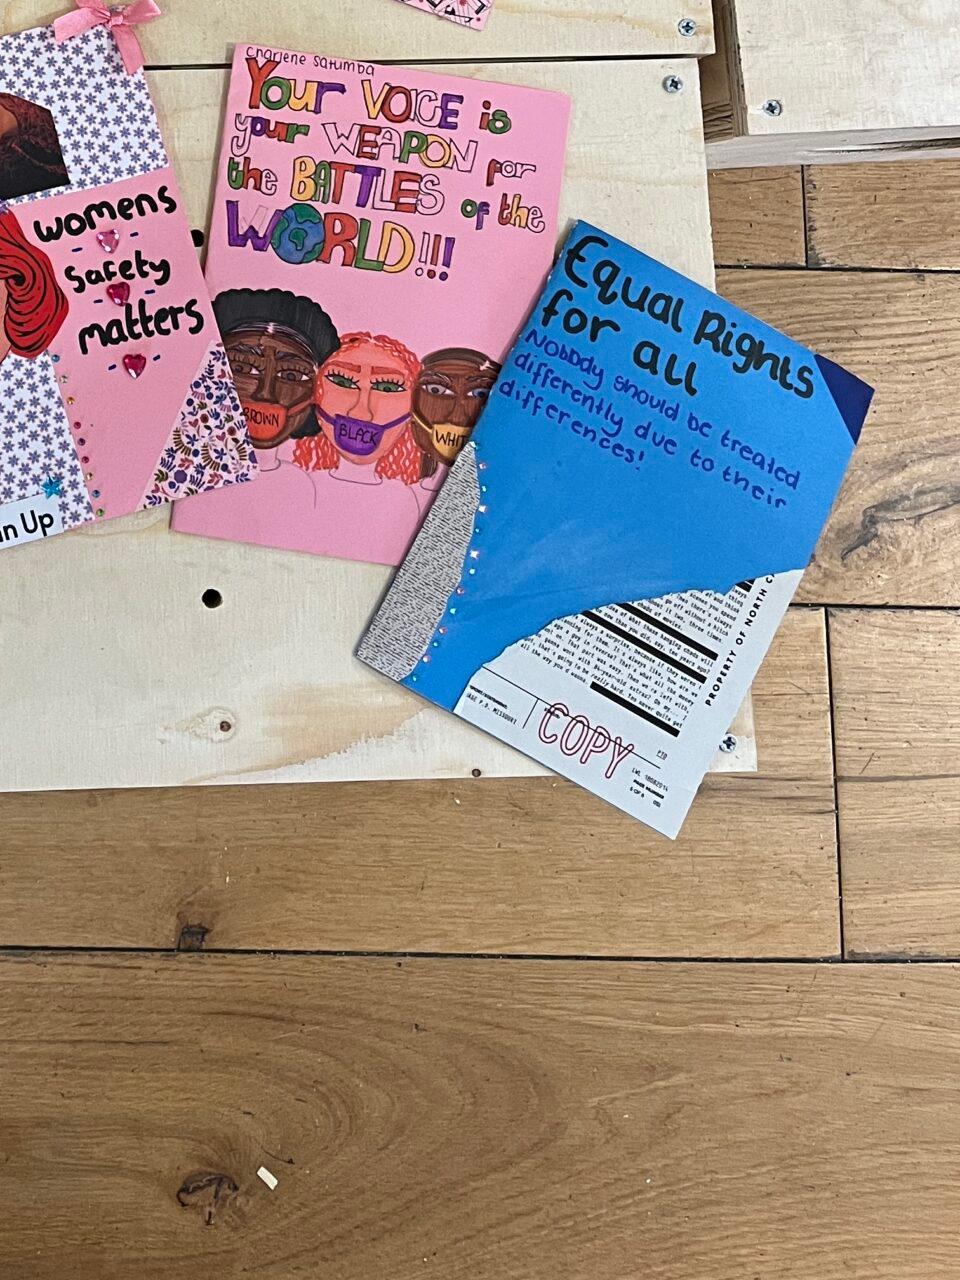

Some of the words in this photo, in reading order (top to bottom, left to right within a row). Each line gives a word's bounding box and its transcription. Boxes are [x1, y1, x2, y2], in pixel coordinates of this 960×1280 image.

[245, 57, 347, 115] Your
[361, 79, 464, 130] VOICE
[478, 101, 512, 135] is
[230, 113, 311, 157] your
[321, 121, 479, 173] WEAPON
[485, 158, 537, 188] for
[33, 184, 178, 243] womens
[227, 156, 278, 197] the
[290, 155, 446, 216] BATTLES
[460, 197, 491, 231] of
[498, 192, 546, 234] the
[77, 297, 205, 355] matters
[540, 287, 621, 343] for
[563, 233, 685, 333] Equal
[693, 309, 816, 400] Rights
[340, 423, 378, 445] BLACK
[435, 432, 468, 448] WHIT
[497, 378, 648, 472] differences!
[513, 350, 626, 437] differently
[634, 419, 679, 456] due
[689, 447, 716, 474] to
[723, 463, 787, 512] their
[612, 374, 680, 422] should
[687, 409, 713, 439] be
[720, 427, 800, 490] treated
[20, 509, 54, 537] Up
[703, 649, 737, 706] PROPERTY
[734, 630, 747, 646] OF
[743, 588, 769, 627] NORTH
[537, 700, 635, 780] COPY
